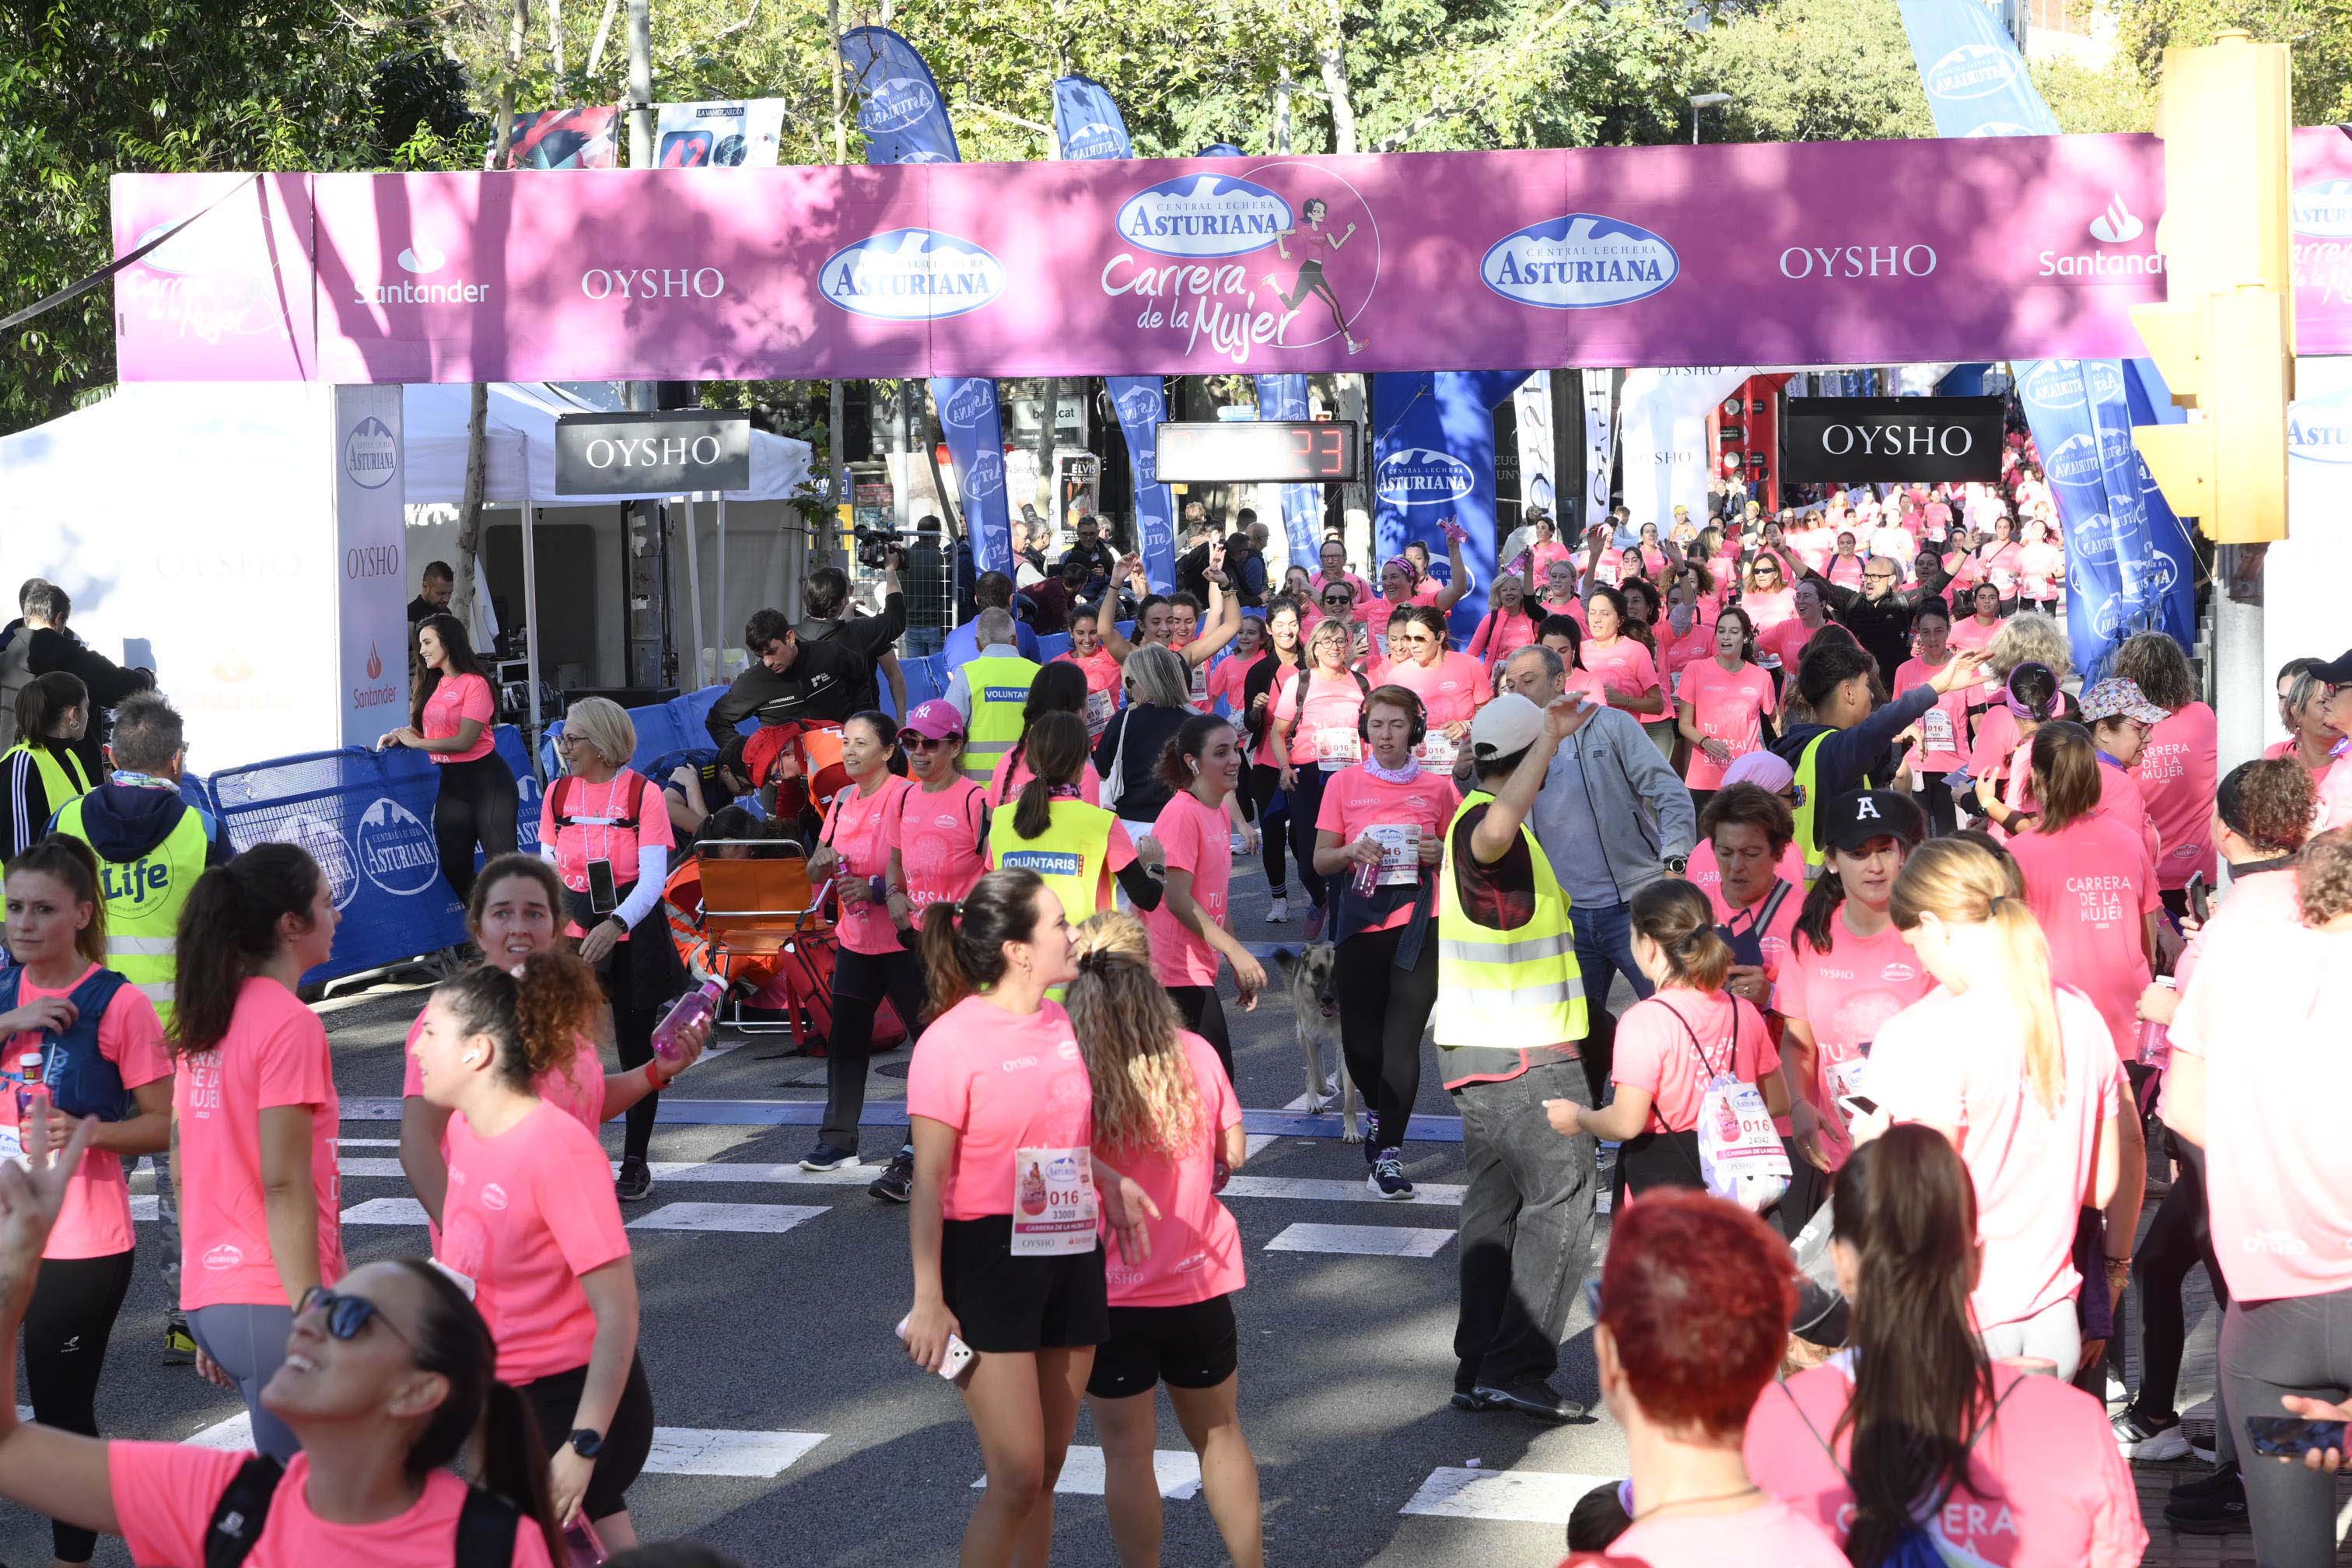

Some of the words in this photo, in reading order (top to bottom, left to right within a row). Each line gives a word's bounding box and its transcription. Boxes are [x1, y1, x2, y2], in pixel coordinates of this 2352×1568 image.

[705, 107, 744, 118] VANGUARDIA
[1157, 202, 1213, 212] CENTRAL
[1217, 201, 1275, 211] LECHERA
[1129, 205, 1280, 236] ASTURIANA
[1527, 247, 1588, 257] CENTRAL
[1594, 245, 1657, 255] LECHERA
[1780, 244, 1937, 278] OYSHO
[1101, 253, 1247, 298] Carrera
[1496, 250, 1663, 285] ASTURIANA
[582, 267, 725, 299] OYSHO
[832, 263, 990, 296] ASTURIANA
[354, 278, 490, 306] Santander
[1137, 299, 1163, 328] de
[1171, 296, 1189, 328] la
[1185, 291, 1300, 364] Mujer
[1822, 425, 1972, 457] OYSHO
[349, 449, 394, 471] ASTURIANA
[586, 436, 721, 468] OYSHO
[1072, 464, 1096, 474] ELVIS
[1378, 471, 1467, 493] ASTURIANA
[348, 544, 398, 579] OYSHO
[354, 684, 397, 709] Santander
[1704, 723, 1718, 734] TU
[2143, 758, 2158, 770] DE
[2164, 755, 2181, 767] LA
[2142, 766, 2184, 781] MUJER
[1350, 797, 1381, 806] OYSHO
[1857, 796, 1881, 821] A
[367, 838, 435, 875] ASTURIANA
[1003, 856, 1076, 870] VOLUNTARIS
[101, 859, 169, 903] Life
[2067, 877, 2133, 893] CARRERA
[1209, 893, 1223, 908] TU
[2080, 892, 2097, 907] DE
[2102, 892, 2121, 906] LA
[2081, 906, 2123, 922] MUJER
[1819, 1043, 1844, 1063] TU
[1743, 1119, 1770, 1132] 016
[1050, 1190, 1080, 1206] 016
[1022, 1238, 1055, 1247] OYSHO
